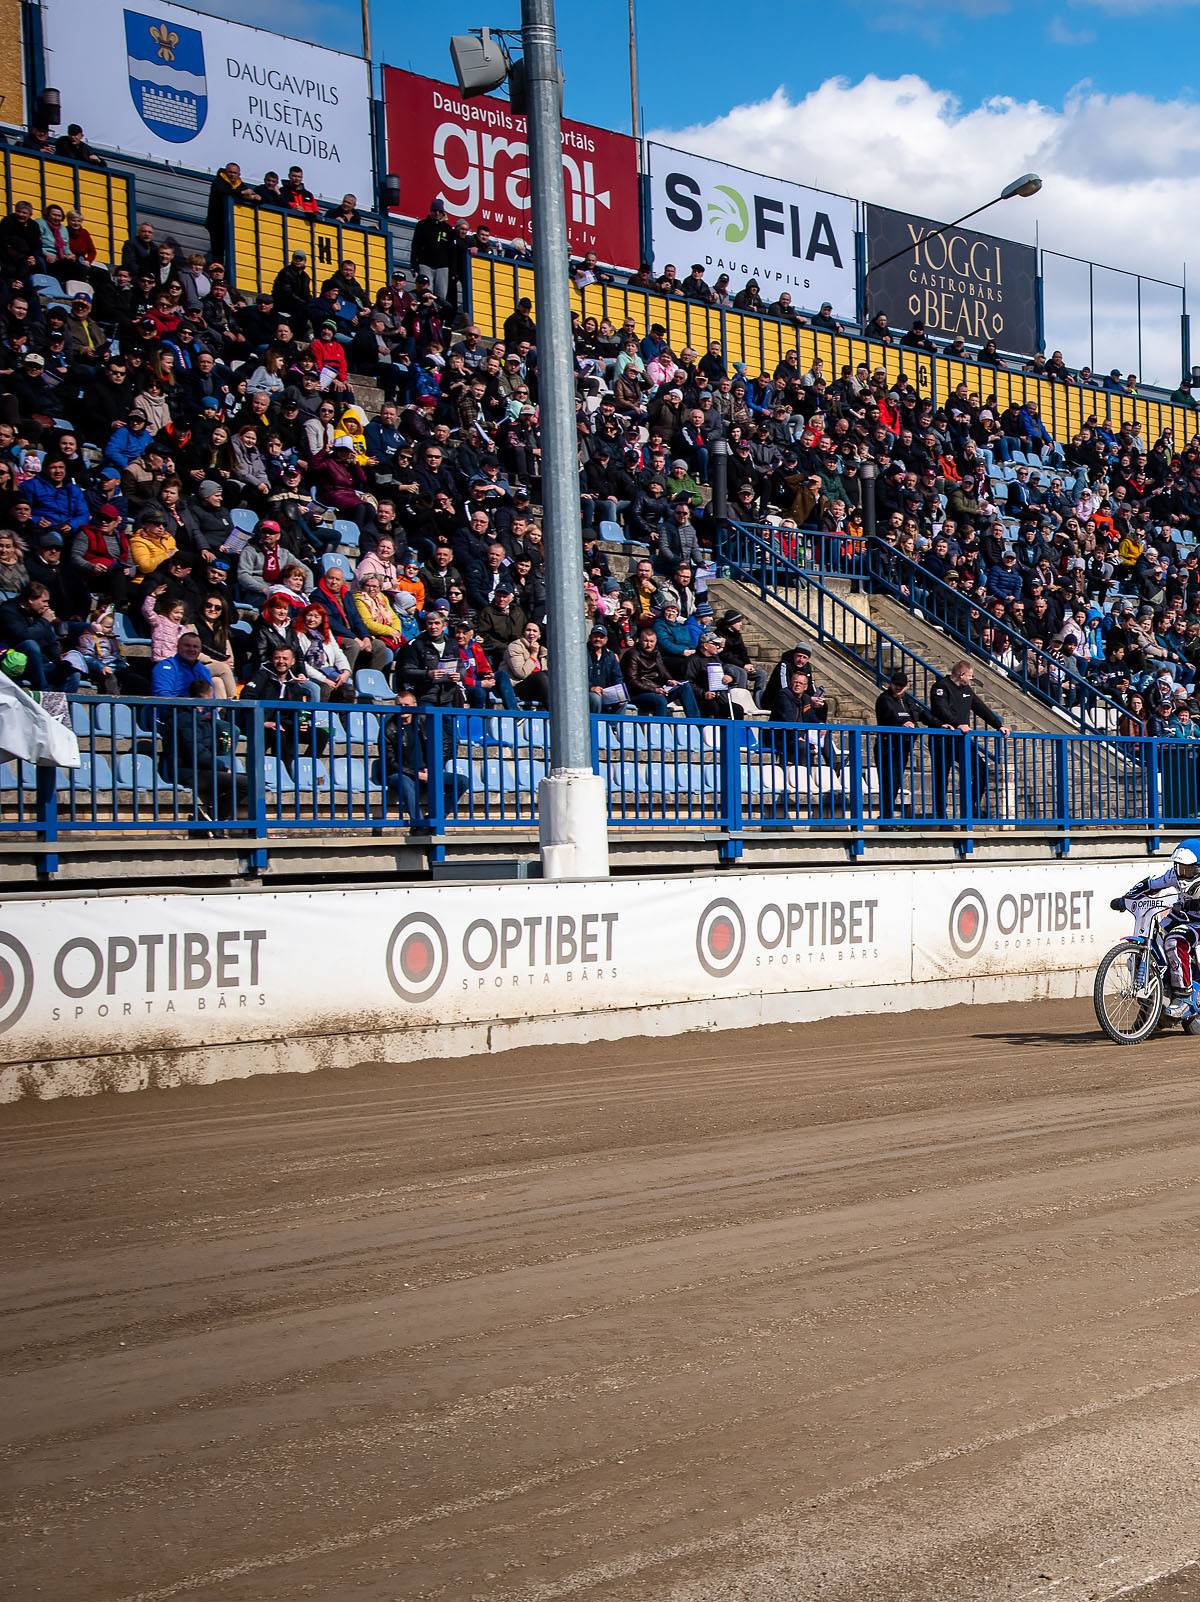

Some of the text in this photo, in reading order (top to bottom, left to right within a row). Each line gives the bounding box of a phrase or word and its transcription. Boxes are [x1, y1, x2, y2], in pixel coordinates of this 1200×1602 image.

[227, 58, 340, 105] DAUGAVPILS
[248, 95, 323, 132] PILSĒTAS
[433, 91, 595, 152] Daugavpils zi ortāls
[232, 118, 341, 163] PAŠVALDĪBA
[482, 209, 596, 245] www.gi.lv
[318, 236, 331, 265] H
[907, 224, 1002, 286] YOGGI
[705, 255, 810, 288] DAUGAVPILS
[909, 269, 1003, 302] GASTROBĀRS
[919, 365, 927, 387] G
[997, 890, 1094, 935] OPTIBET
[1138, 900, 1163, 908] OPTIBET
[462, 913, 619, 971] OPTIBET
[757, 900, 878, 949] OPTIBET
[994, 933, 1095, 950] SPORTA BĀRS
[53, 930, 267, 999] OPTIBET
[755, 948, 879, 967] SPORTA BĀRS
[462, 967, 618, 990] SPORTA BĀRS
[52, 993, 266, 1021] SPORTA BĀRS
